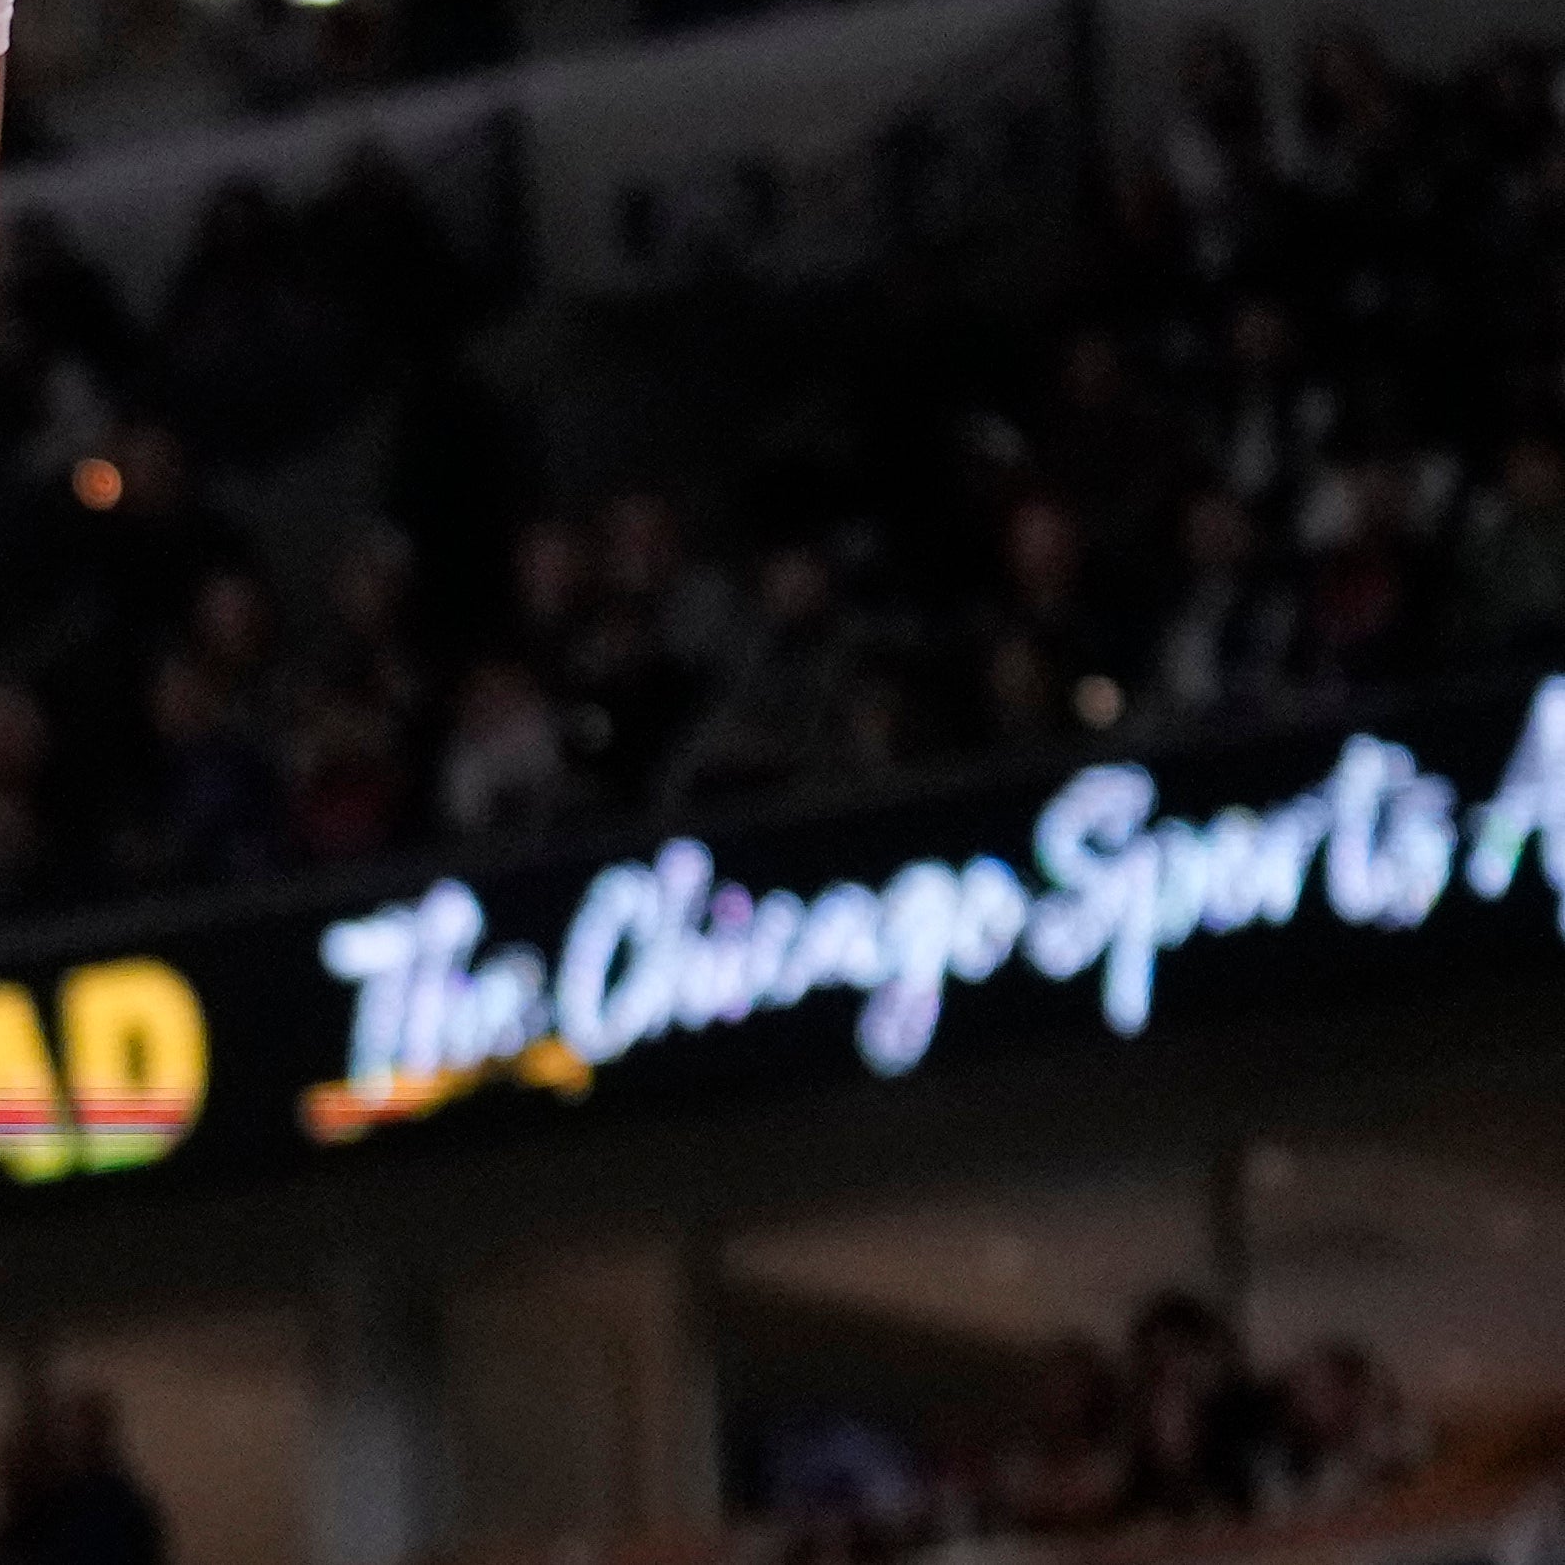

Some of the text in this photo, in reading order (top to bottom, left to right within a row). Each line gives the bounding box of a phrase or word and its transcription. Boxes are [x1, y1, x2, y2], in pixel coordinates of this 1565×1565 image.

[320, 877, 554, 1103] The
[556, 837, 1030, 1077] Chicago
[1021, 734, 1458, 1035] Sports
